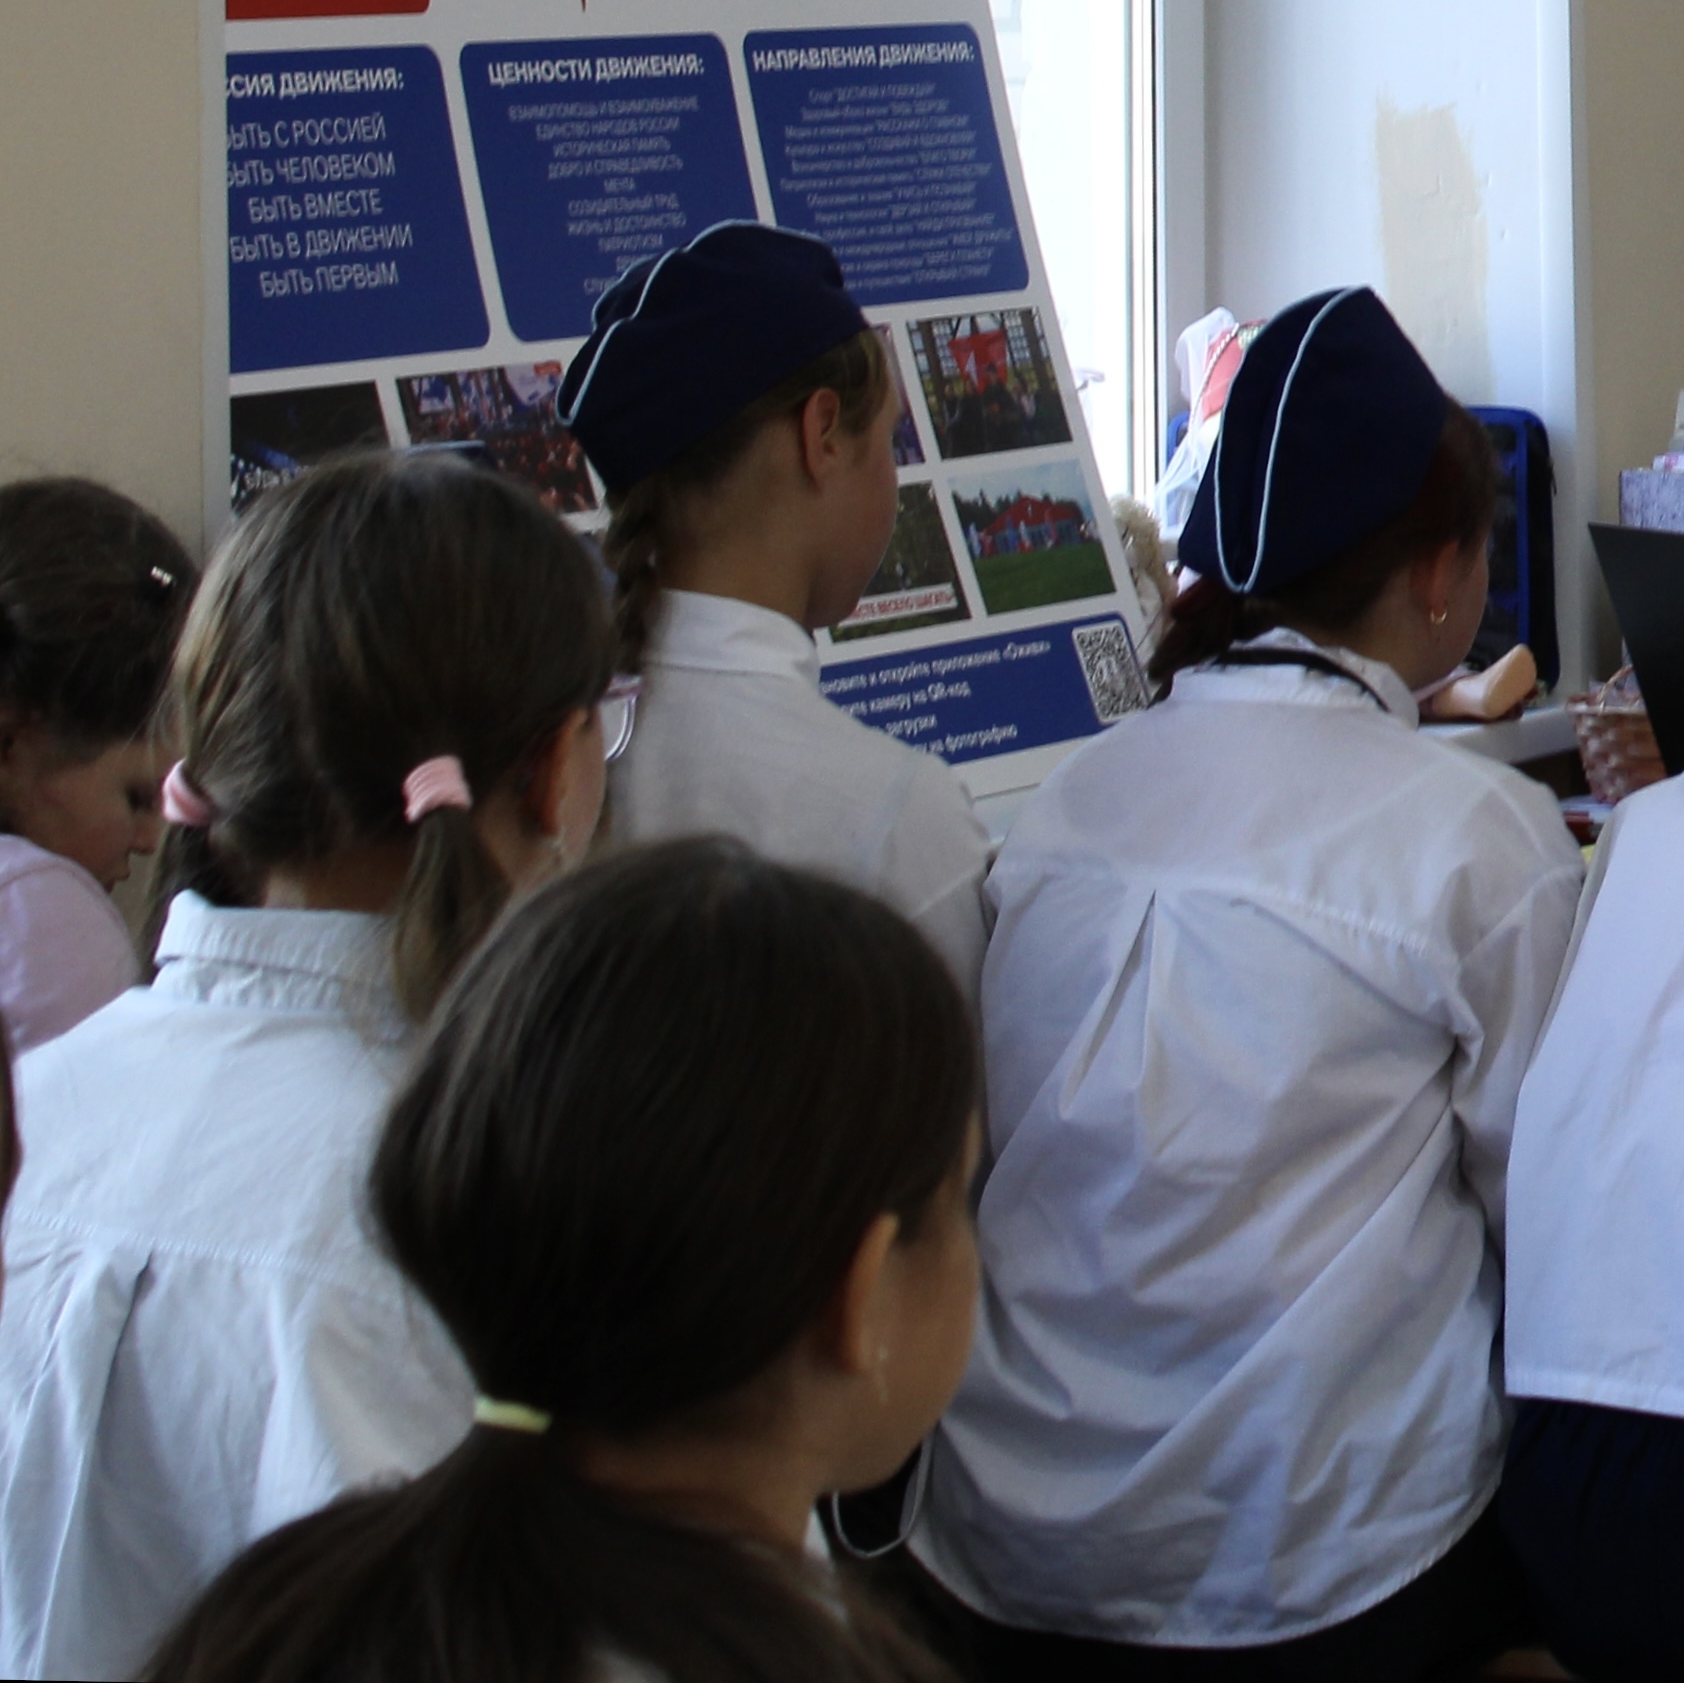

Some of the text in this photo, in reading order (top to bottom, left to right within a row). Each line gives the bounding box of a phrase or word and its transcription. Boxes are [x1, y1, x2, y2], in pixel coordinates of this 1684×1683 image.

[488, 53, 705, 87] ЦЕННОСТИ ДВИЖЕНИЯ:
[752, 41, 975, 73] НАПРАВЛЕНИЯ ДВИЖЕНИЯ:
[226, 67, 404, 99] СИЯ ДВИЖЕНИЯ:
[274, 120, 290, 147] С
[291, 112, 387, 149] РОССИЕЙ
[276, 151, 396, 184] ЧЕЛОВЕКОМ
[248, 188, 384, 224] БЫТЬ ВМЕСТЕ
[229, 223, 413, 264] БЫТЬ В ДВИЖЕНИИ
[259, 260, 399, 299] БЫТЬ ПЕРВЫМ
[868, 671, 878, 687] и
[878, 659, 930, 685] откройте
[931, 649, 1001, 677] приложение
[869, 691, 912, 713] камеру
[912, 688, 928, 705] на
[927, 680, 972, 702] QR-код
[944, 723, 1019, 755] фотографию
